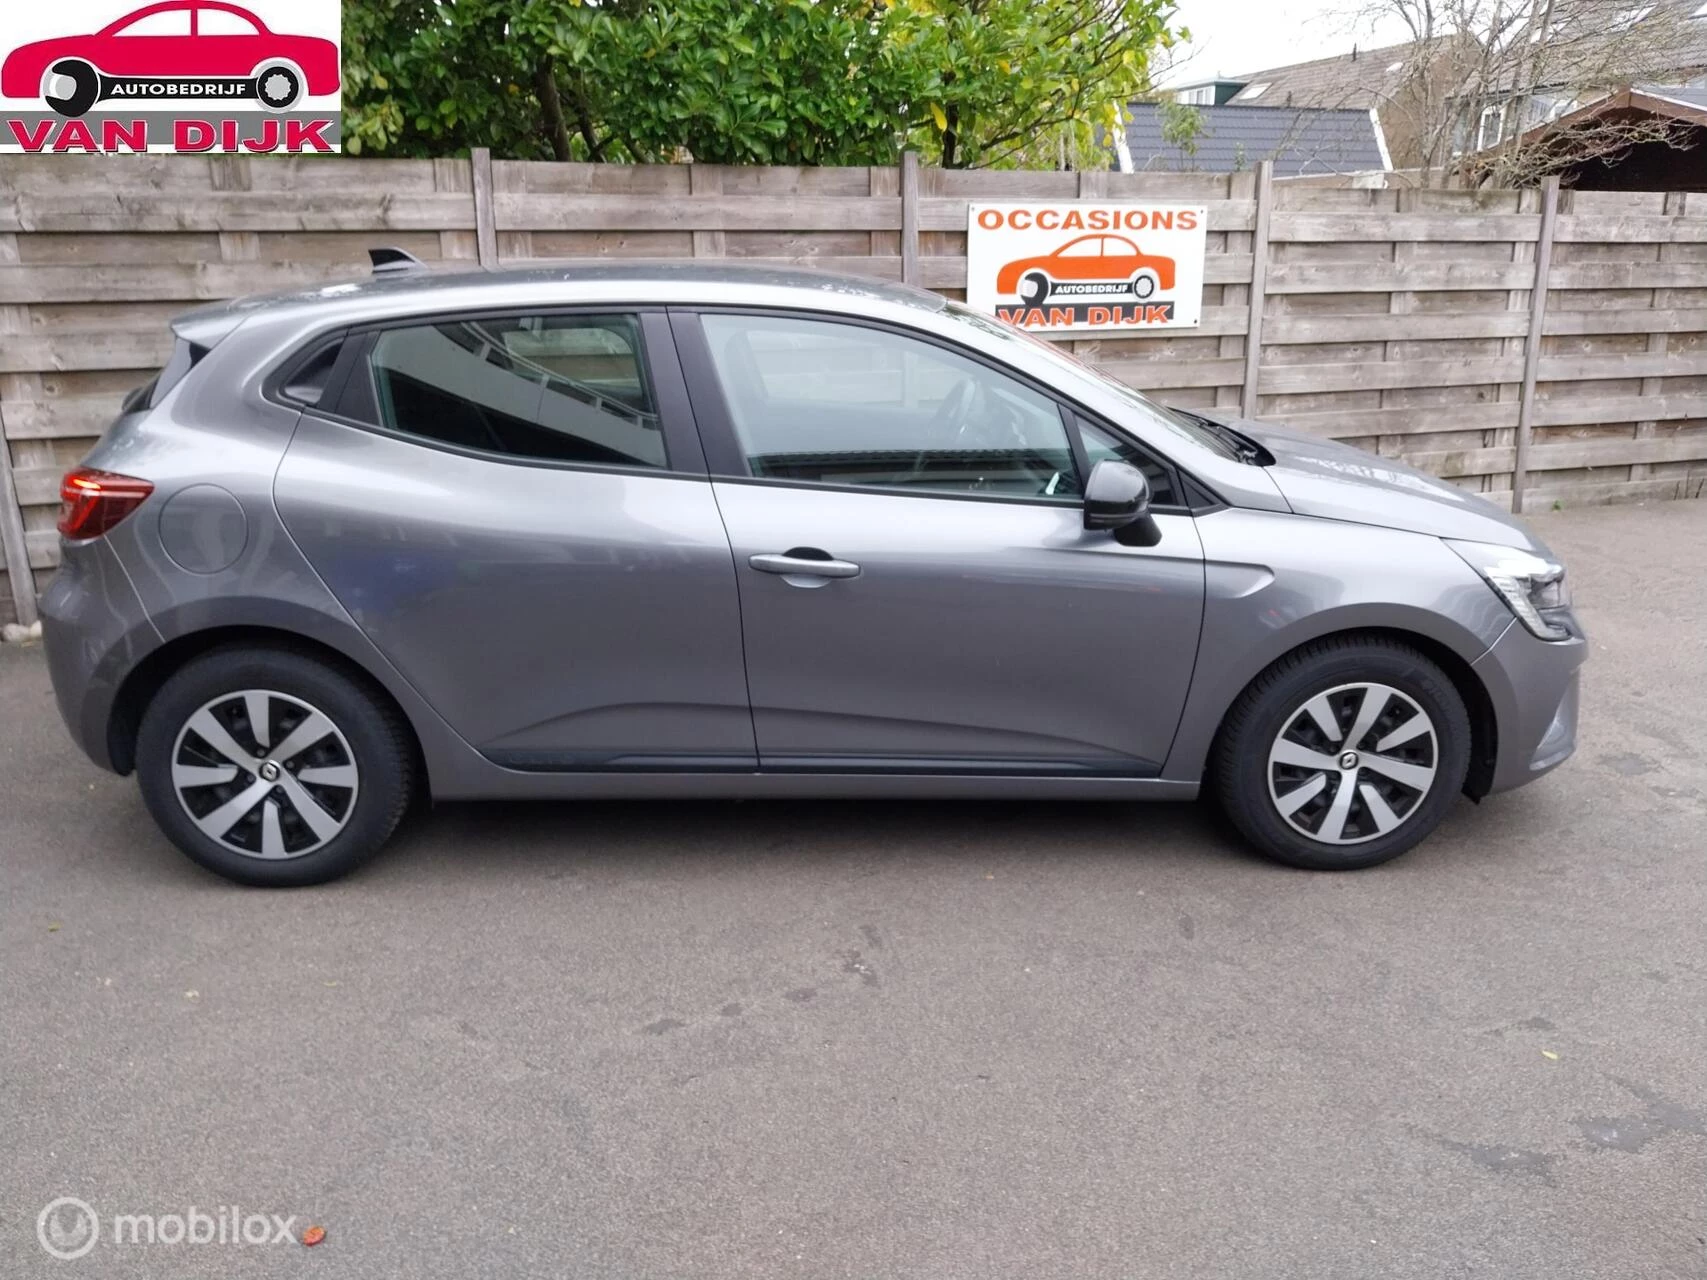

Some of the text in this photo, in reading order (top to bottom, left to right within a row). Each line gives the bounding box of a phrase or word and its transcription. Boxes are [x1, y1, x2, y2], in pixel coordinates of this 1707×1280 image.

[977, 209, 1198, 230] OCCASIONS
[1055, 283, 1129, 294] AUTOBEDRIJF
[998, 305, 1171, 326] VAN DIJK
